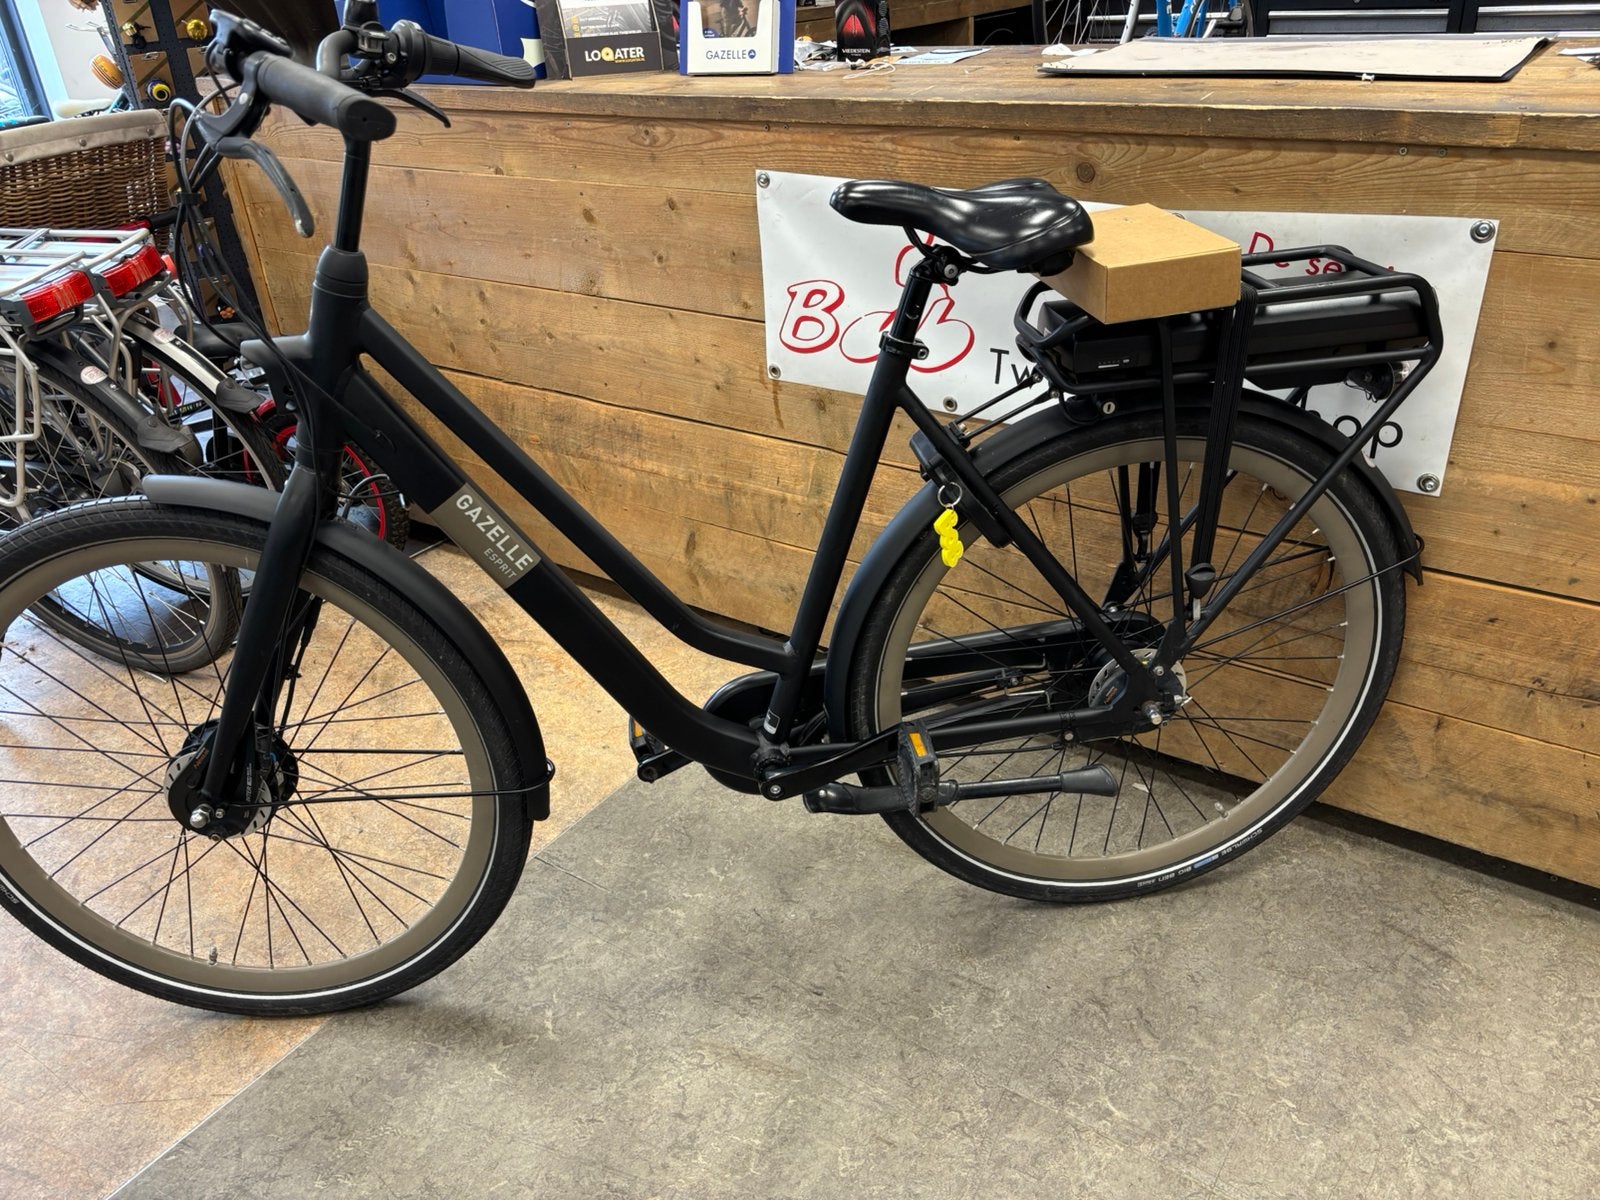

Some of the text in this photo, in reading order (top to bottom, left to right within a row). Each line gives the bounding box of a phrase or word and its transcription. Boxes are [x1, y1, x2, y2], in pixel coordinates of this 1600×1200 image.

[584, 46, 645, 62] LOQATER
[705, 49, 747, 60] GAZELLE
[456, 494, 534, 571] GAZELLE
[483, 547, 517, 578] ESPRIT
